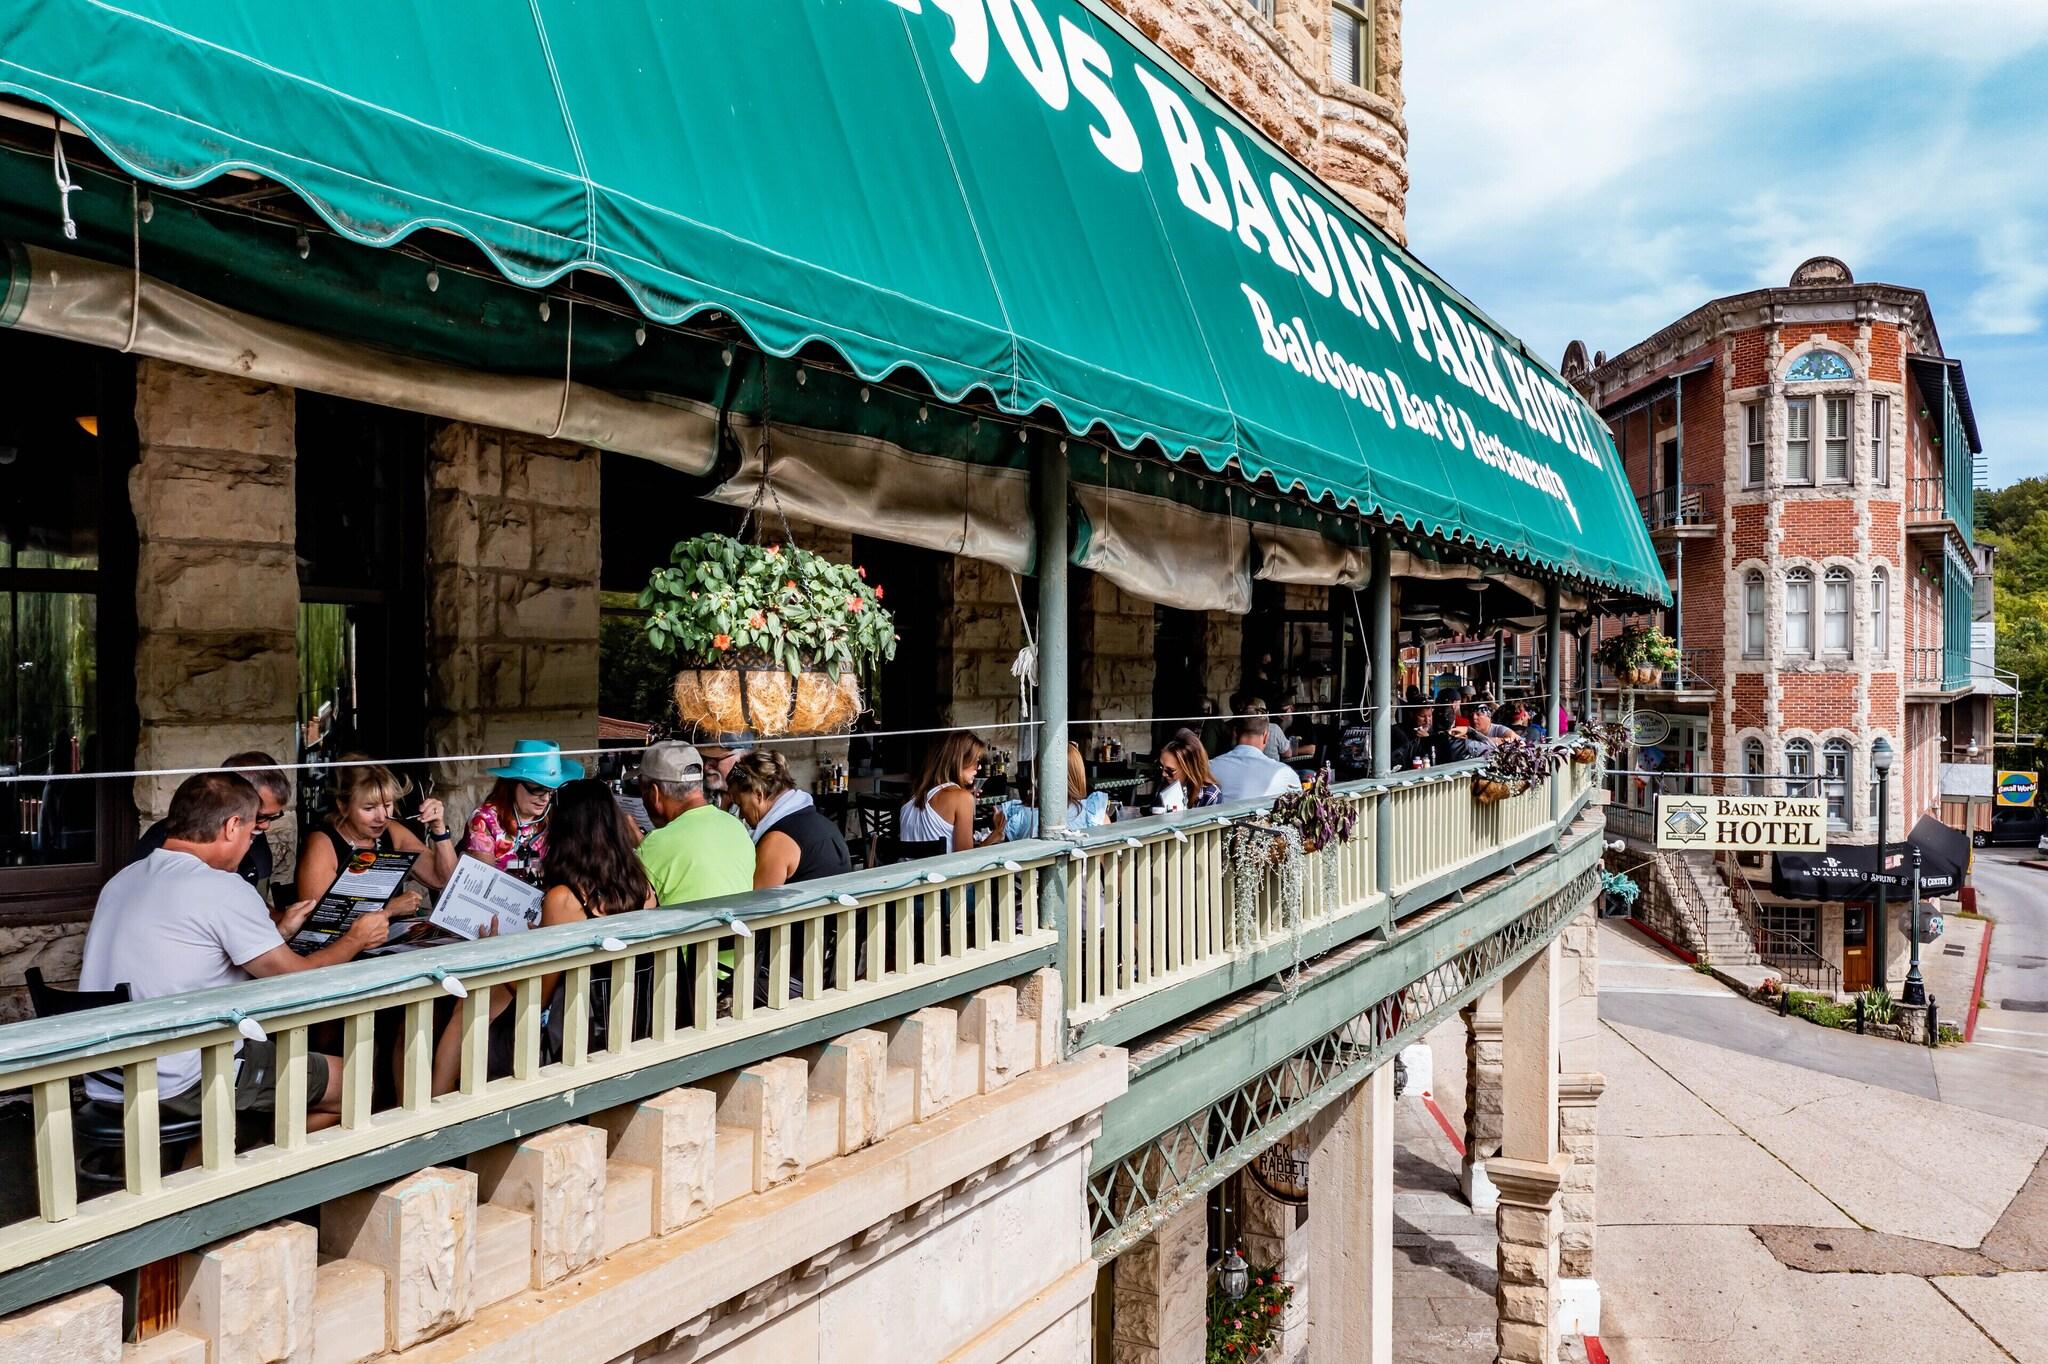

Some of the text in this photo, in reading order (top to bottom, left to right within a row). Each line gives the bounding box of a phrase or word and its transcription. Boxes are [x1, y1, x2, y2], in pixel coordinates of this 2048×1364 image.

[1134, 63, 1402, 343] BASIN
[1381, 254, 1523, 421] PARK
[1500, 346, 1604, 472] HOTEL
[1240, 282, 1565, 501] Balcony Bar & Restaurant
[1998, 782, 2037, 793] Small World
[1717, 800, 1820, 817] BASIN PARK
[1715, 821, 1821, 846] HOTEL
[1802, 870, 1860, 878] SOAPER
[1870, 873, 1897, 884] SPRING
[1927, 877, 1948, 888] CENTER
